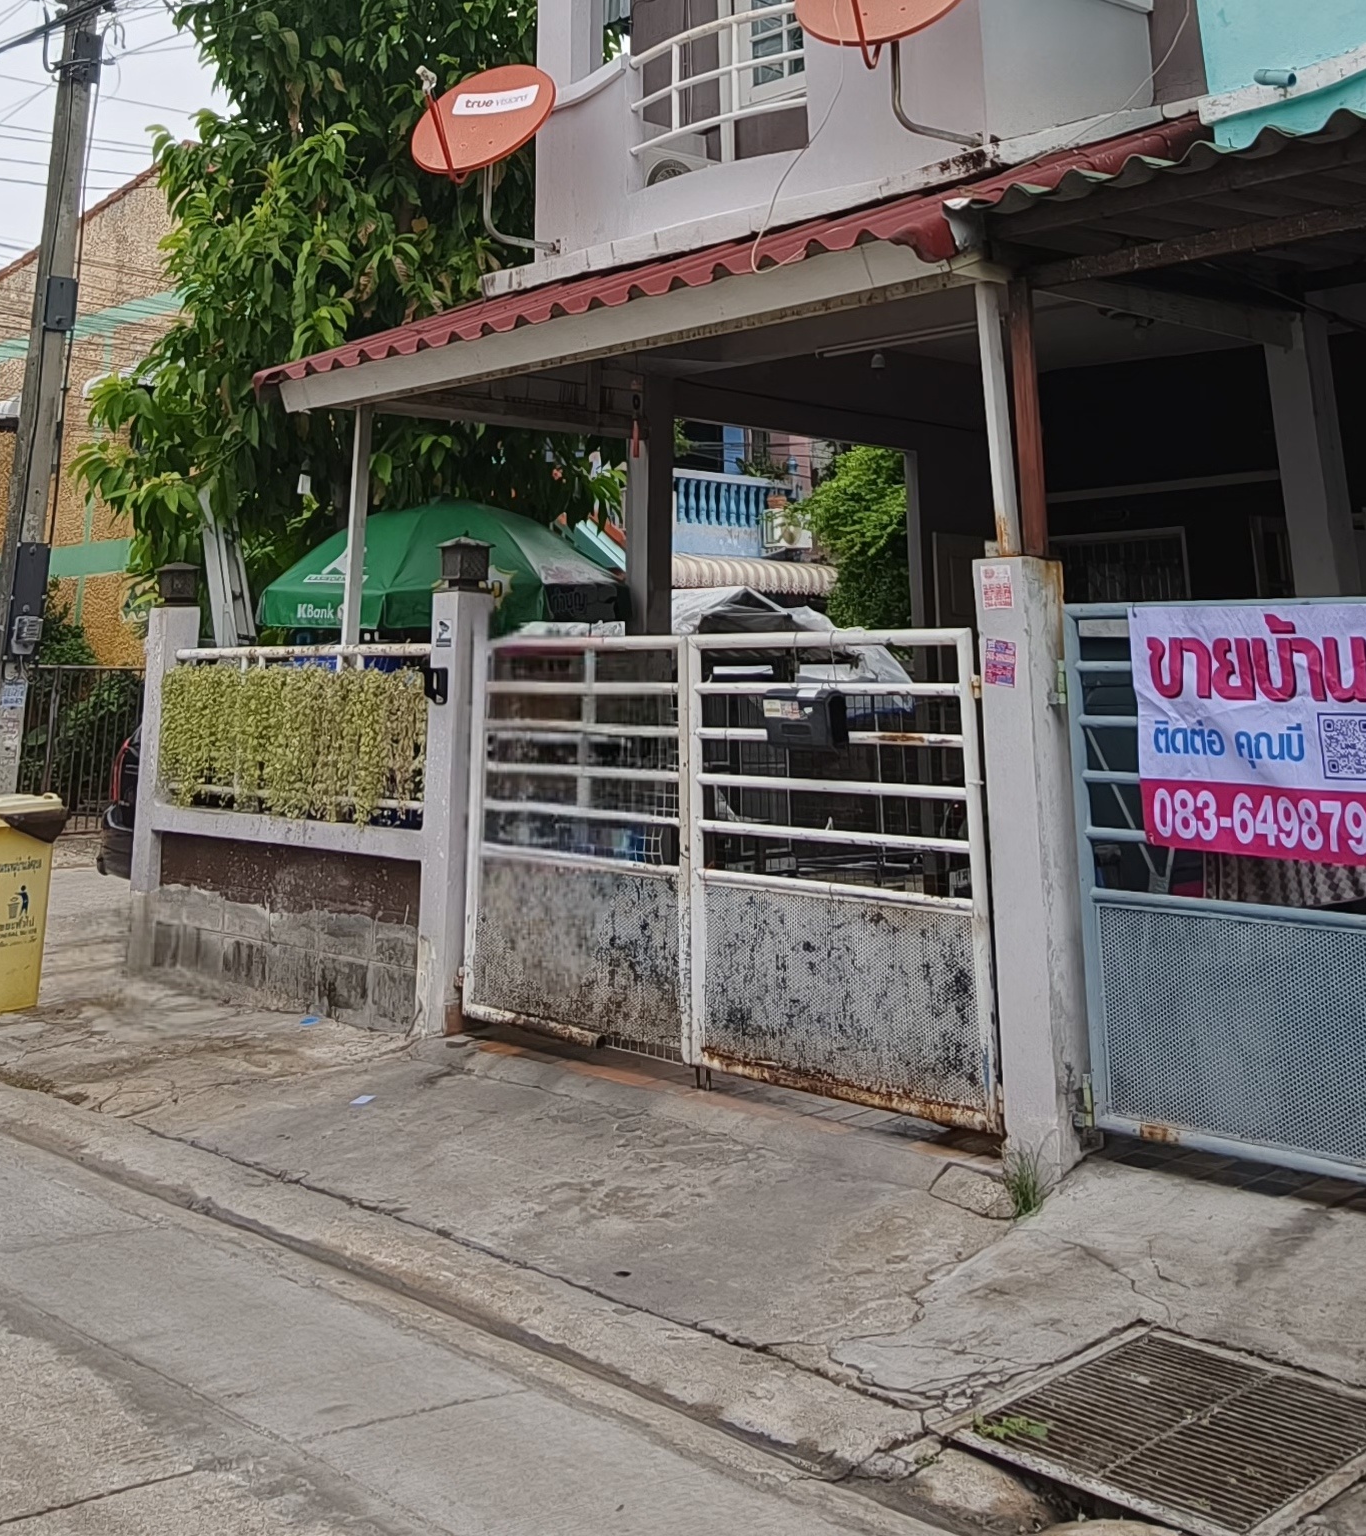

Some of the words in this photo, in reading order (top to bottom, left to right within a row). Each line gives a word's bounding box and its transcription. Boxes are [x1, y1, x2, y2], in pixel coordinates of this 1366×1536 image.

[465, 99, 494, 109] true
[297, 602, 335, 619] KBank
[1153, 719, 1226, 757] ติดต่อ
[1234, 722, 1305, 770] คุณบี
